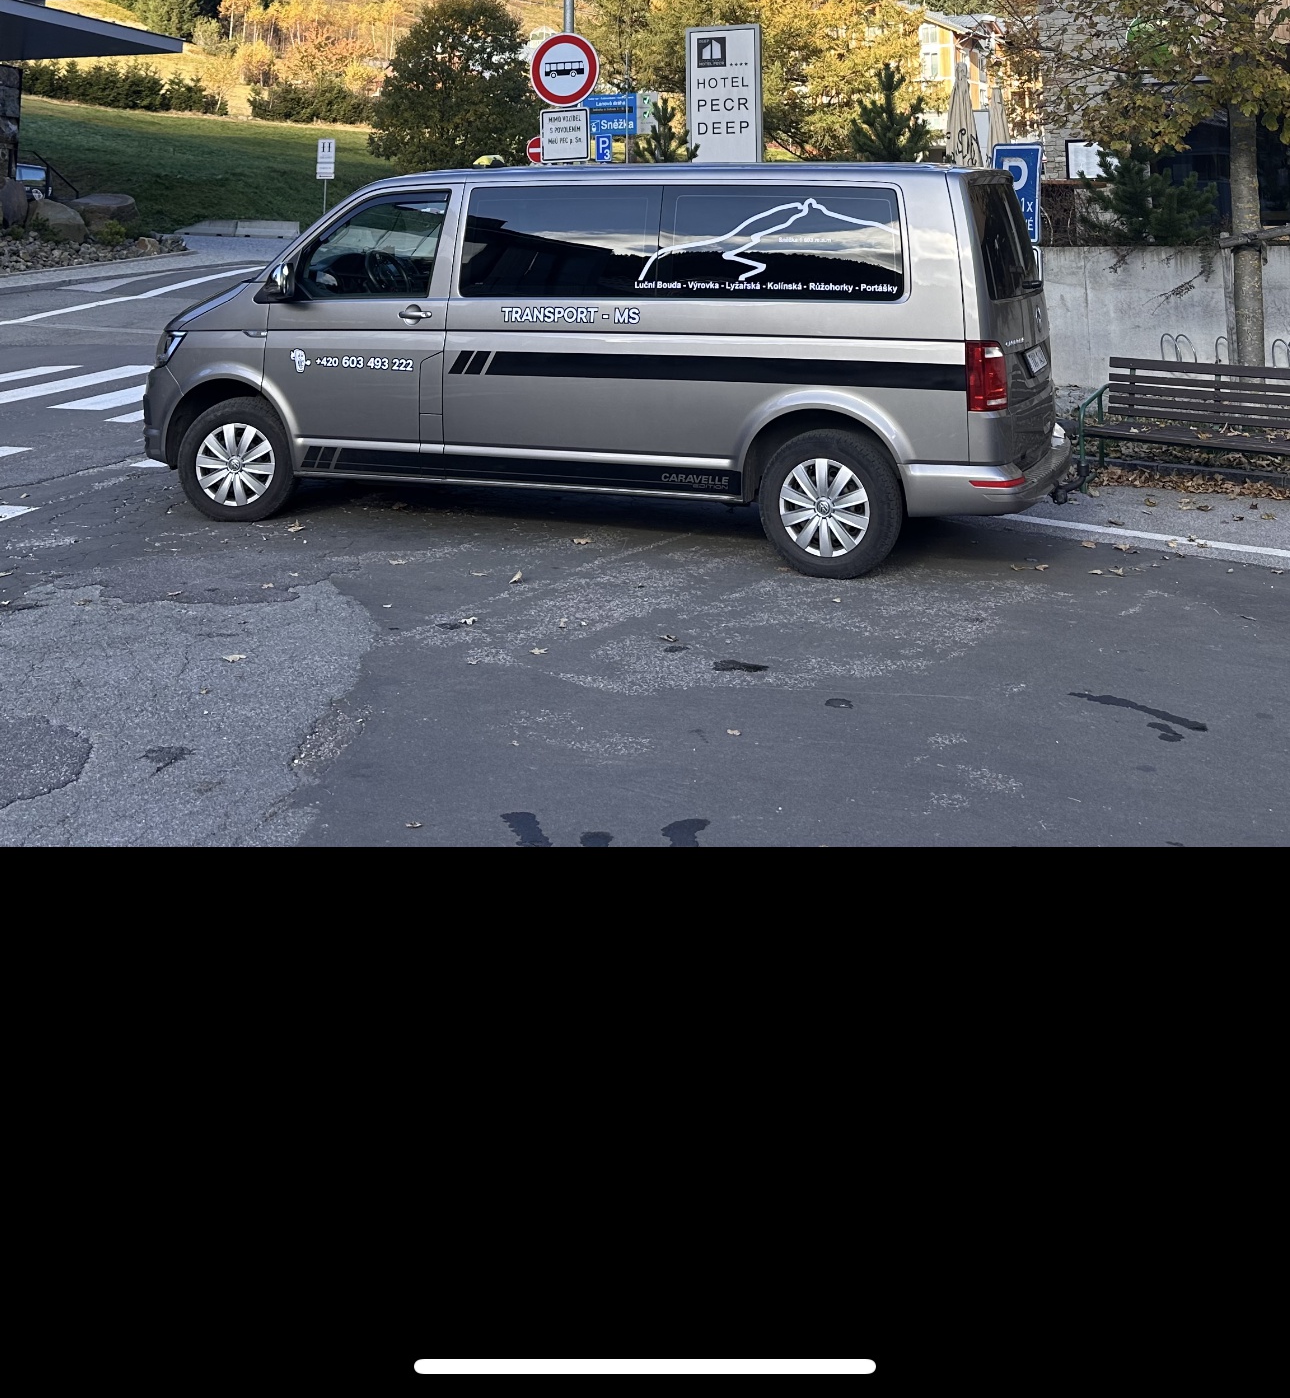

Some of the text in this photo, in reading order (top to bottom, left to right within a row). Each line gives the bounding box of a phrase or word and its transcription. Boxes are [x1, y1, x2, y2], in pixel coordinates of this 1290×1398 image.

[697, 76, 749, 89] HOTEL
[697, 98, 749, 112] PECR
[554, 125, 581, 133] POVOLENÍM
[697, 121, 749, 135] DEEP
[600, 138, 609, 153] P
[604, 149, 611, 160] 3
[1002, 157, 1028, 190] P
[688, 281, 719, 290] Výrovka
[726, 282, 760, 291] Lyžařská
[767, 282, 802, 290] Kolínská
[809, 282, 853, 293] Růžohorky
[861, 283, 898, 293] Portášky
[501, 306, 599, 323] TRANSPORT
[614, 307, 640, 324] MS
[316, 356, 413, 371] +420 603 493 222
[661, 473, 729, 485] CARAVELLE
